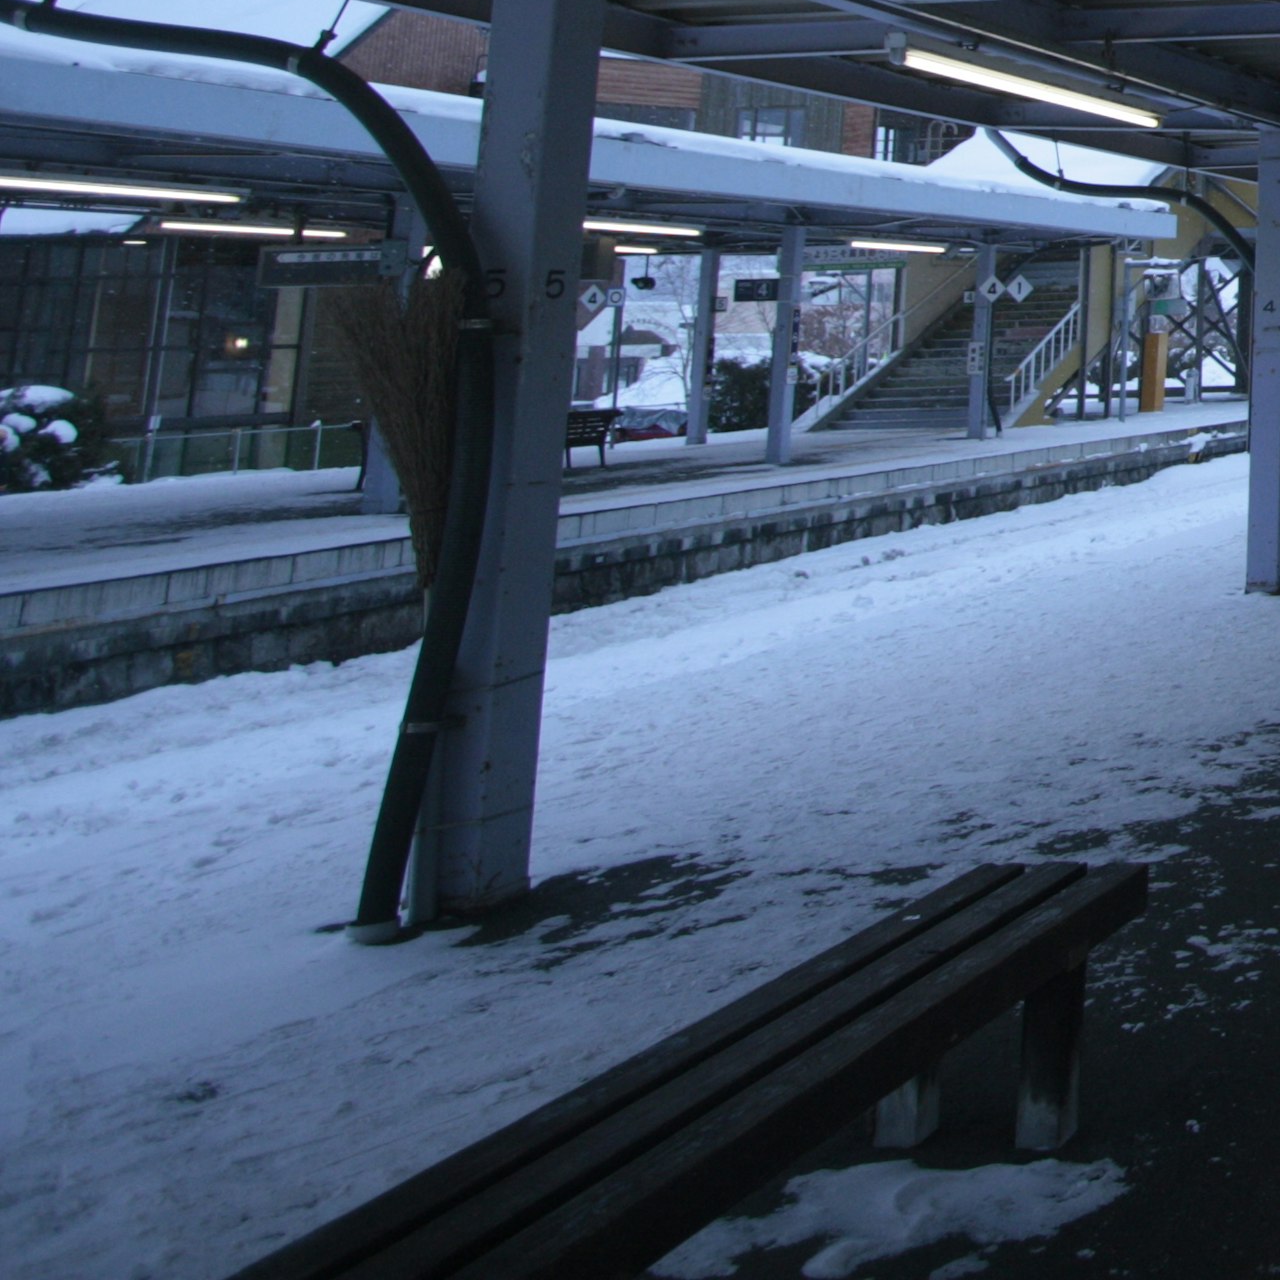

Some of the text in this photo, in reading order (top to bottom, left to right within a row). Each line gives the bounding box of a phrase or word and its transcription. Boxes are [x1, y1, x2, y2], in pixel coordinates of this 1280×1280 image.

[546, 270, 565, 299] 5
[988, 282, 997, 294] 4
[1017, 282, 1022, 295] 1
[588, 292, 597, 304] 4
[1262, 300, 1277, 313] 4
